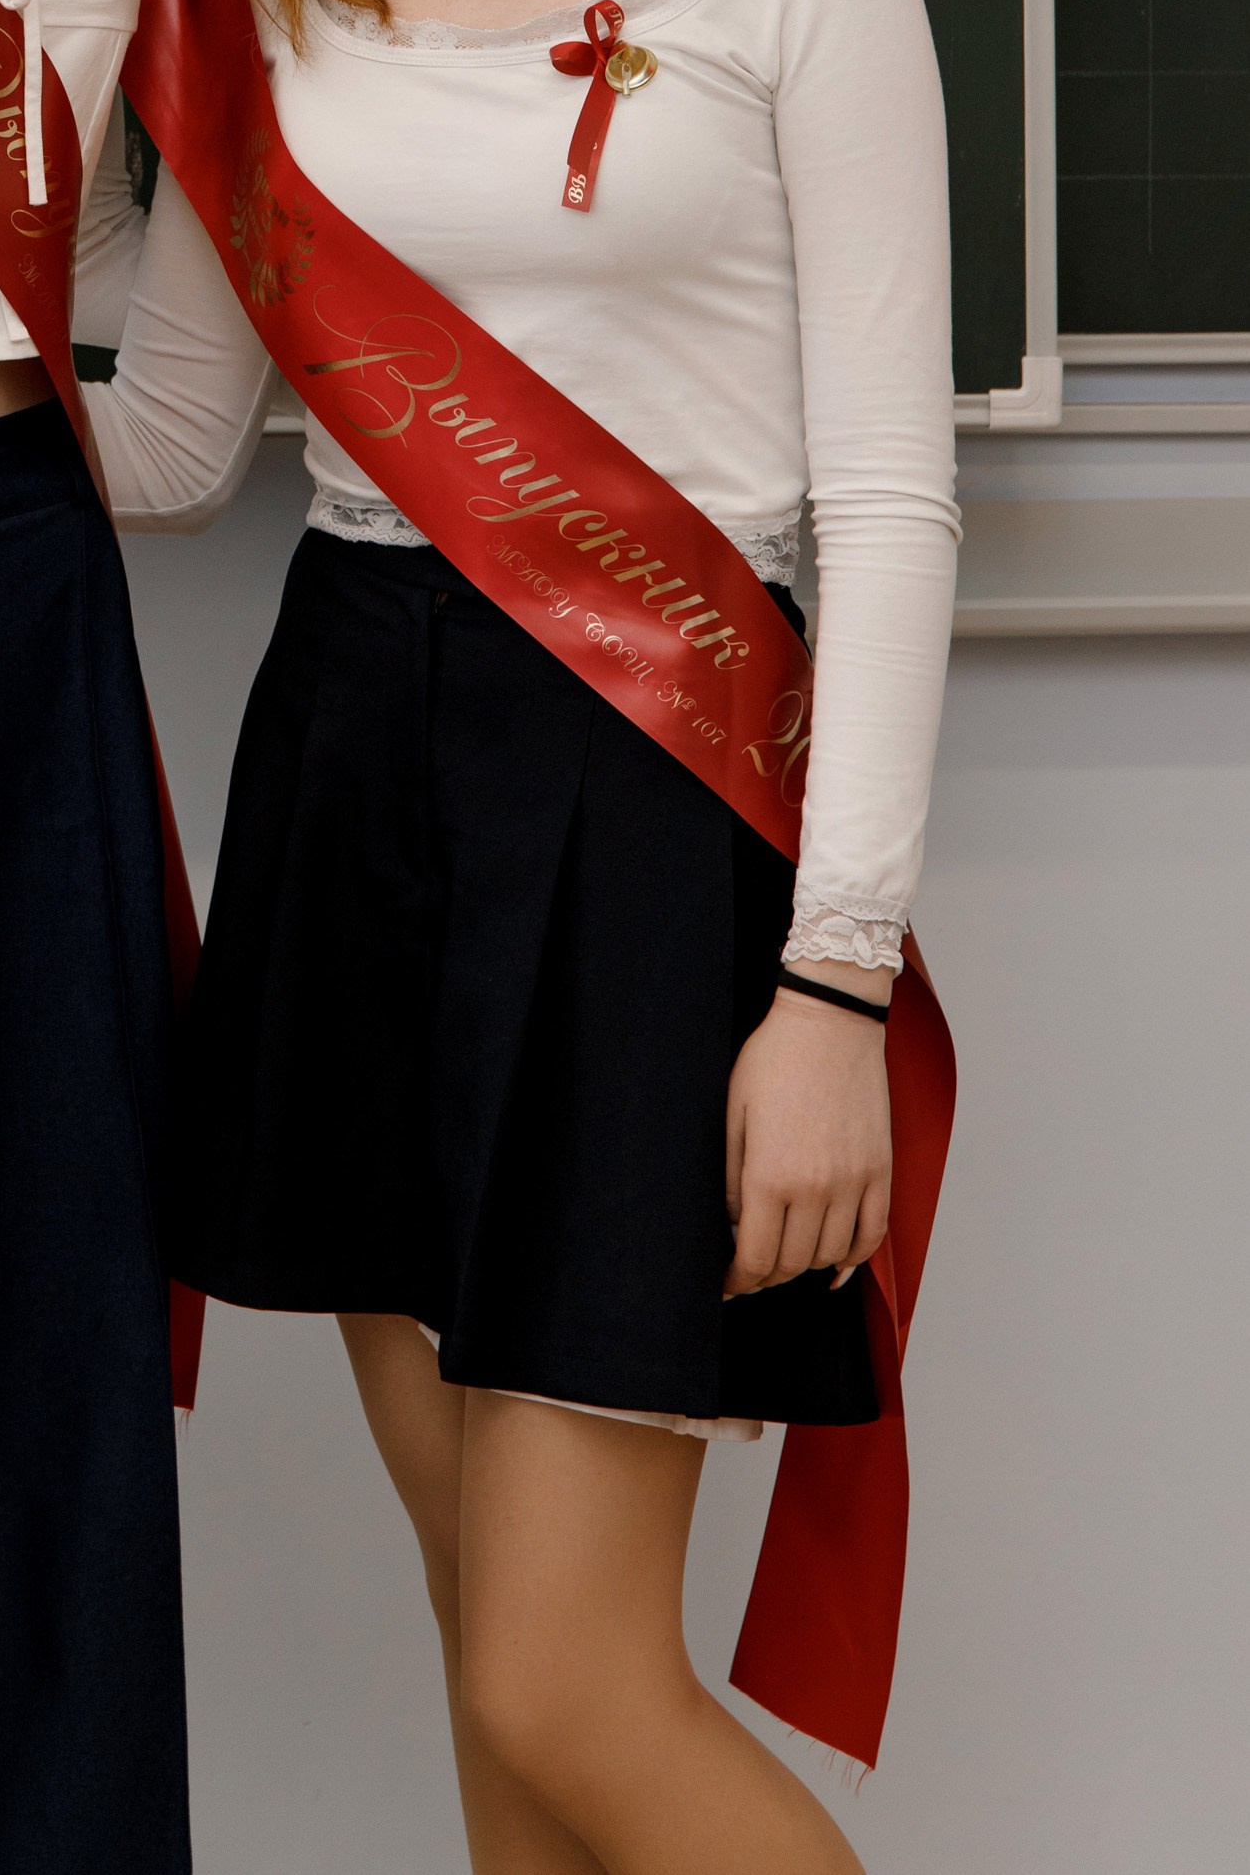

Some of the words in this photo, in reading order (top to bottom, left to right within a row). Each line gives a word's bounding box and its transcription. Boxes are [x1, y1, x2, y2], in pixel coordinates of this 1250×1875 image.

[302, 285, 750, 671] Выпускник
[486, 533, 579, 619] МАОУ
[585, 612, 655, 687] СОШ
[656, 680, 698, 712] №
[691, 716, 728, 745] 107
